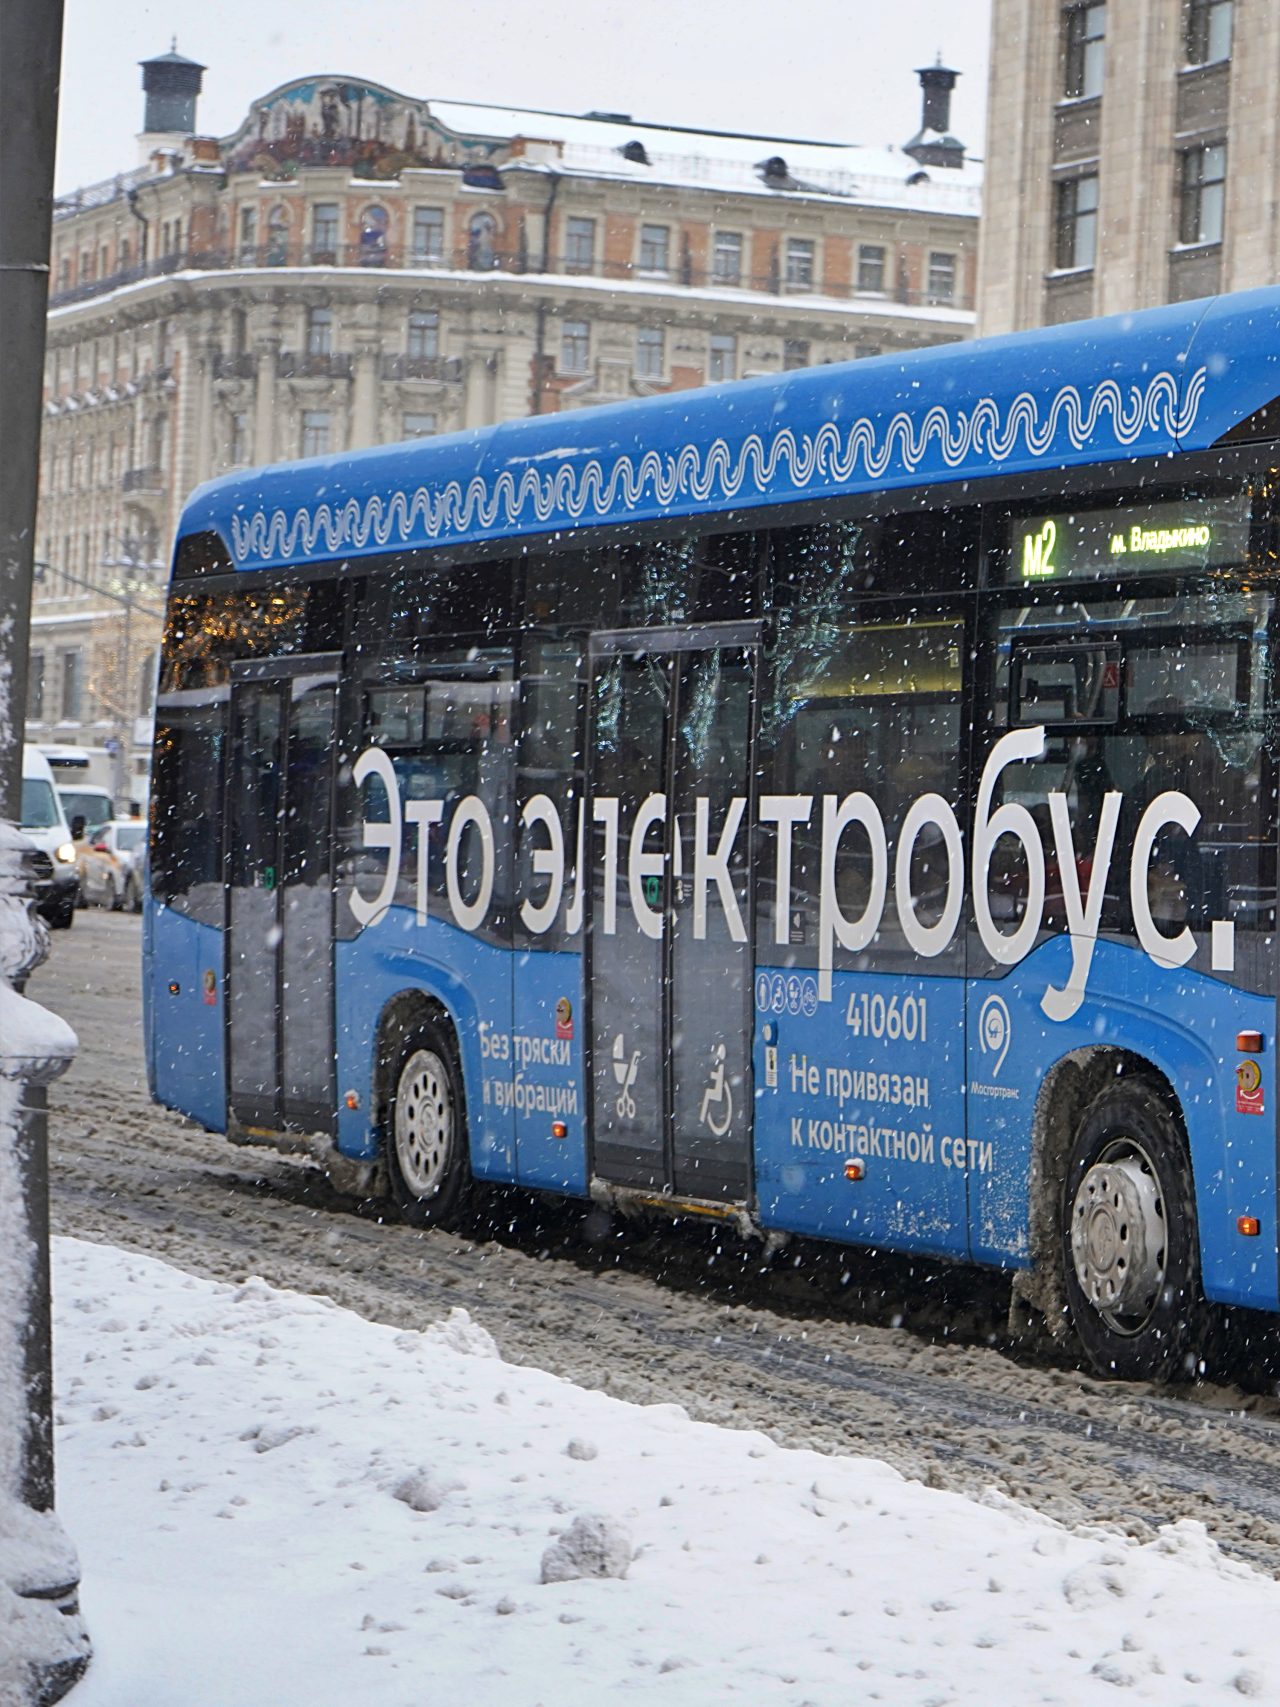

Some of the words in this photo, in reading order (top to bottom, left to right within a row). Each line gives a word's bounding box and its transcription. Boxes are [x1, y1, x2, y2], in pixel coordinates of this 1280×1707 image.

[1023, 520, 1057, 576] М2
[1131, 526, 1210, 554] Владыкино
[349, 747, 495, 932] Это
[520, 725, 1235, 1022] электробус.
[846, 992, 928, 1042] 410601
[479, 1023, 510, 1060] Без
[513, 1036, 571, 1070] тряски
[482, 1080, 491, 1105] и
[494, 1073, 578, 1119] вибраций
[790, 1055, 820, 1096] Не
[825, 1066, 929, 1108] привязан
[971, 1081, 1020, 1100] Мосгортранс
[790, 1117, 803, 1147] к
[808, 1119, 935, 1165] контактной
[941, 1135, 993, 1173] сети
